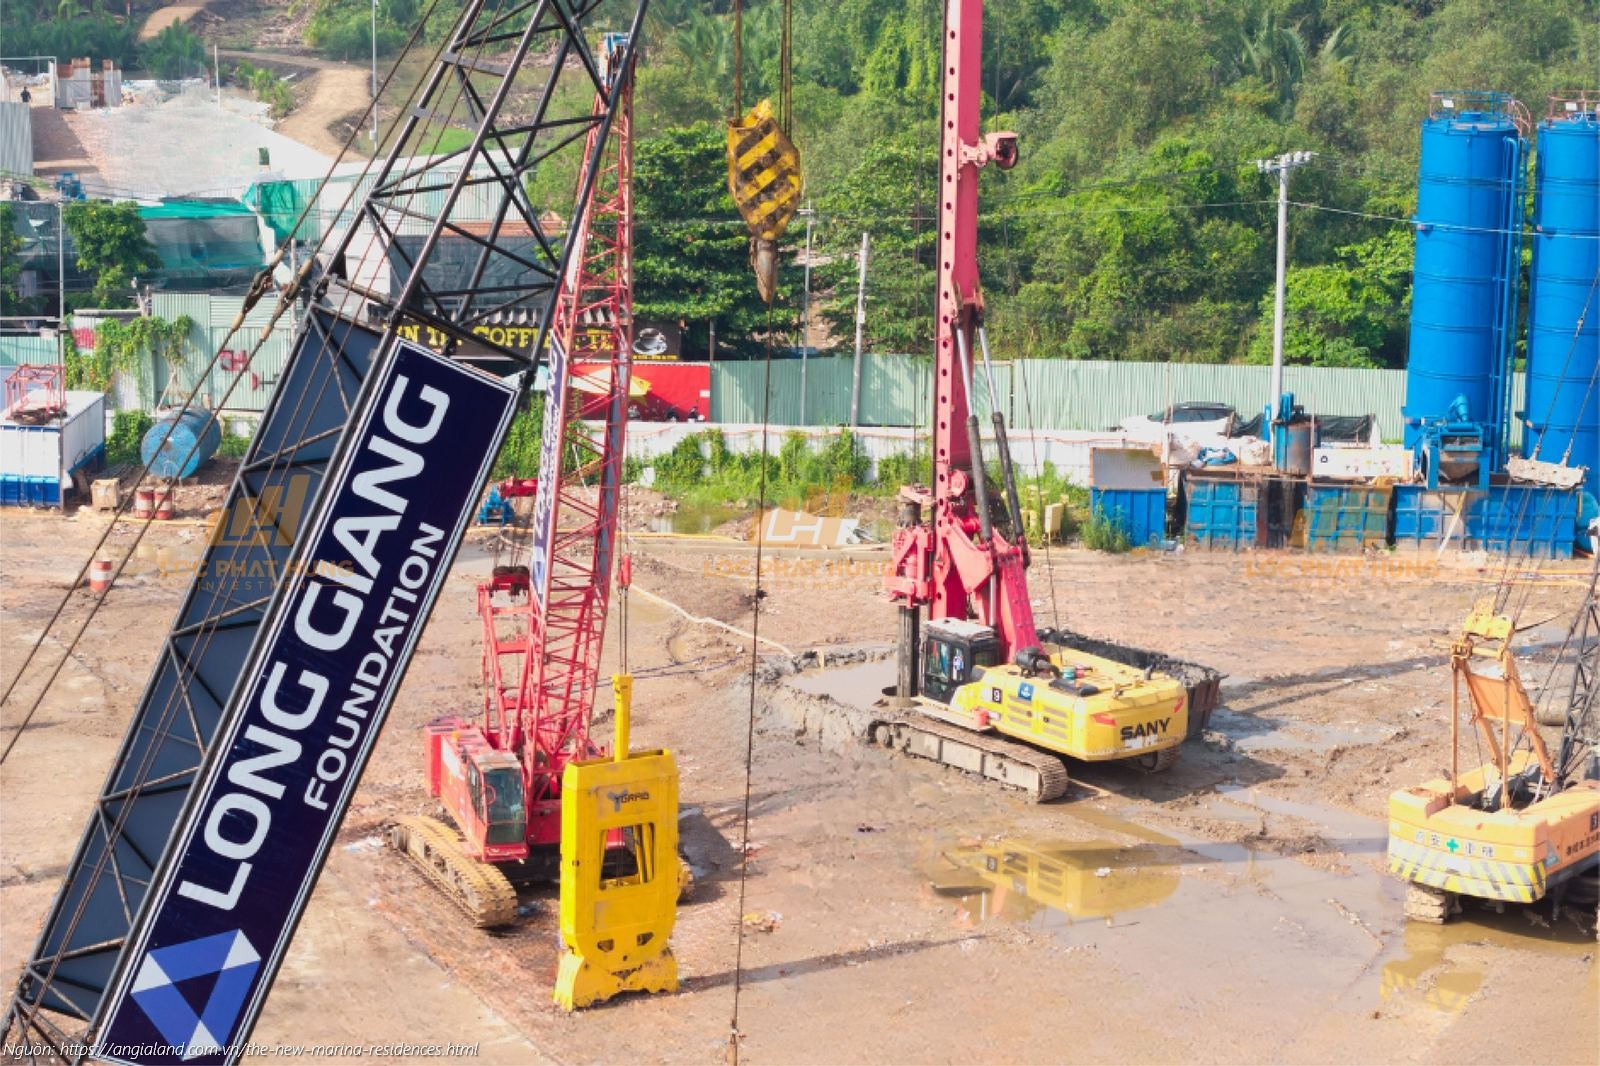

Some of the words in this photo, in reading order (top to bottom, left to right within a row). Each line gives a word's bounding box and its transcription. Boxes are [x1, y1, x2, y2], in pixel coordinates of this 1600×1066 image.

[177, 661, 330, 911] LONG
[294, 376, 450, 651] GIANG
[304, 522, 445, 811] FOUNDATION
[1121, 717, 1171, 740] SANY
